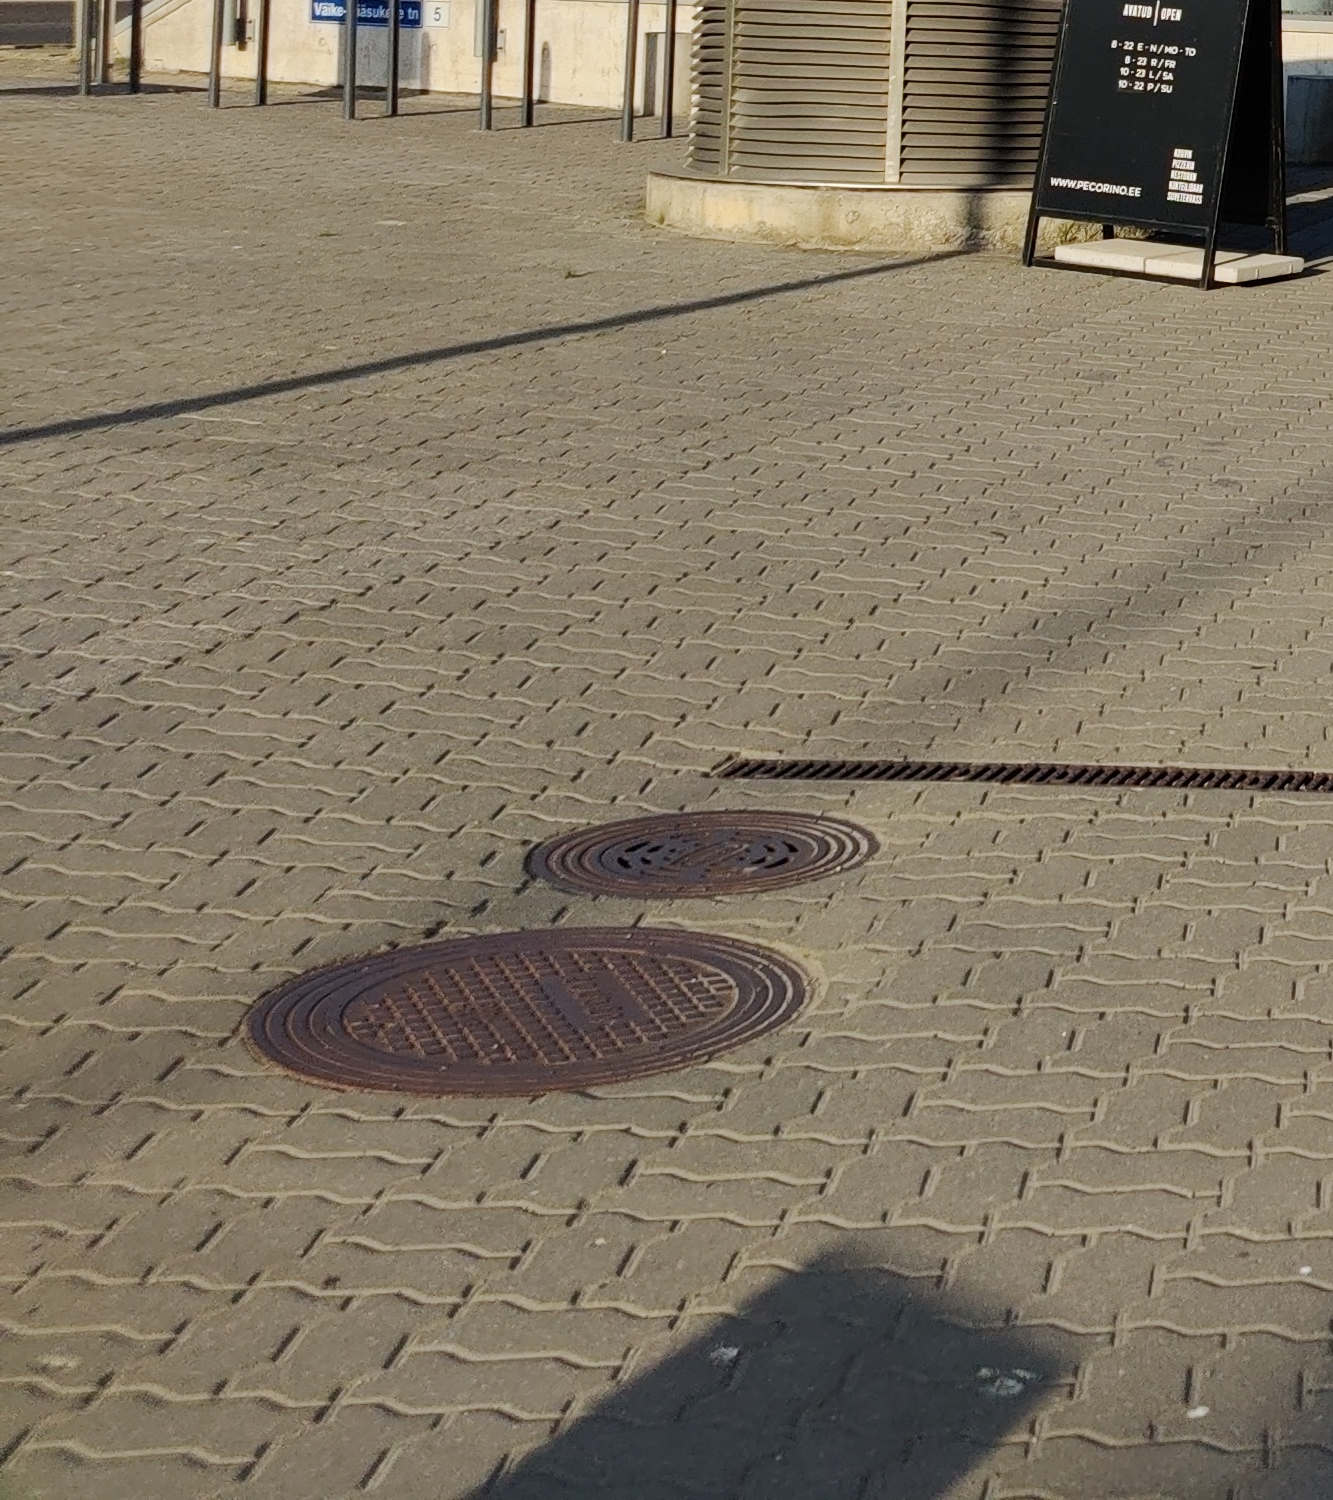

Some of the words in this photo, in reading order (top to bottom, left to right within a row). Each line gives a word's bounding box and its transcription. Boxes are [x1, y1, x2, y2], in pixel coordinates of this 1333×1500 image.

[408, 7, 419, 19] tn
[433, 7, 441, 21] 5
[1122, 3, 1153, 19] AVATUD
[1160, 7, 1182, 21] OPEN
[1050, 177, 1142, 197] WWW.PECORINO.EE
